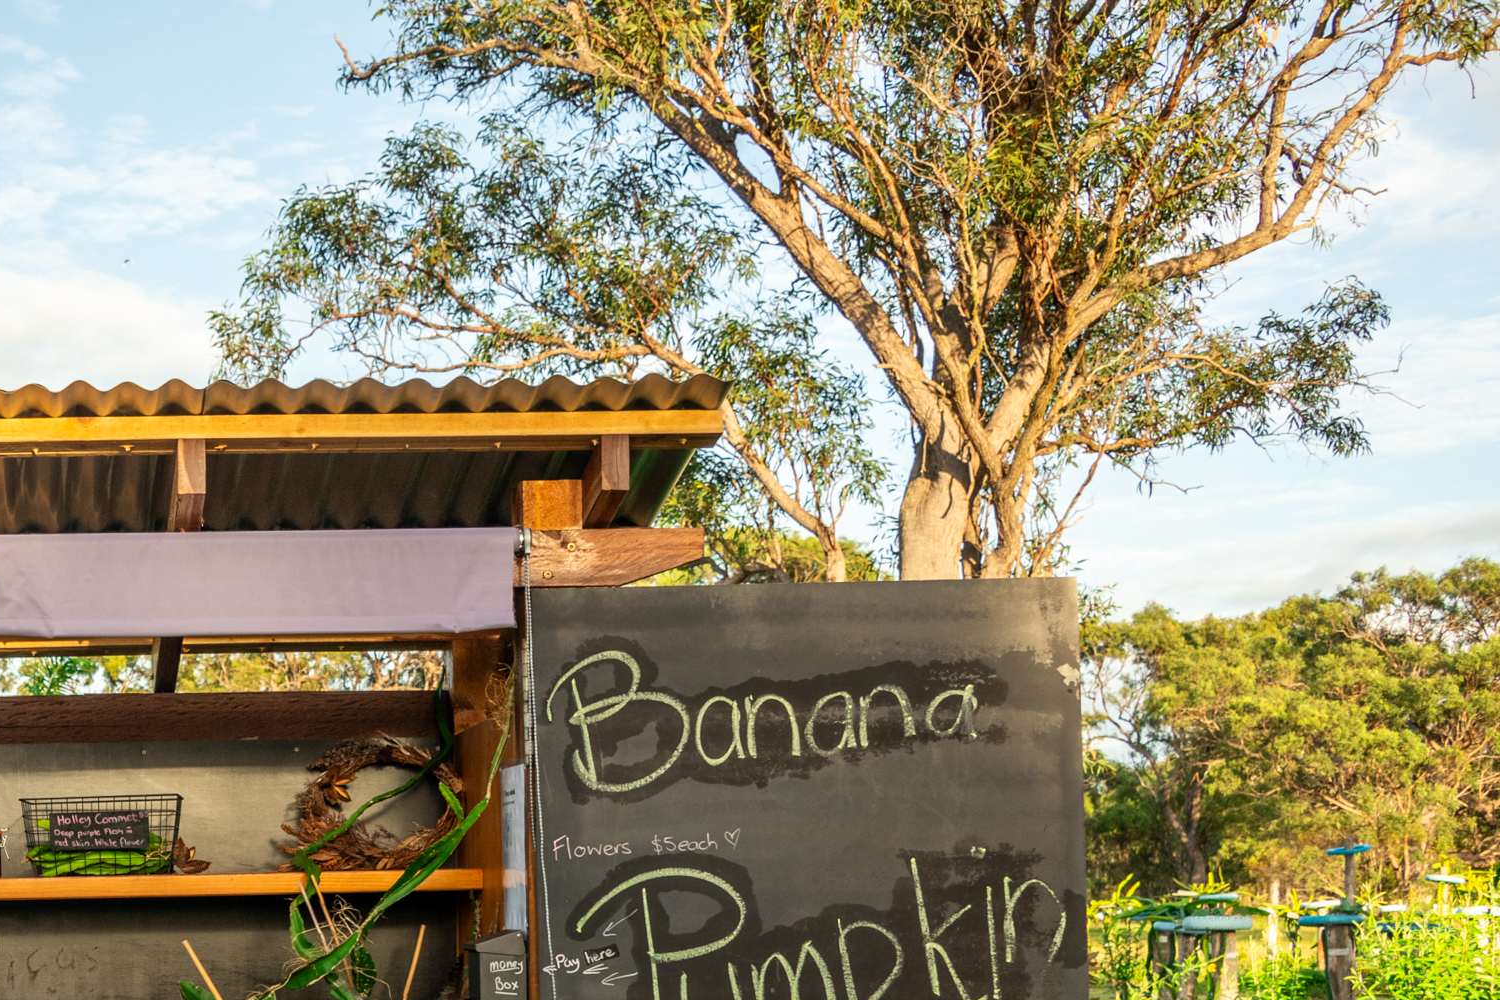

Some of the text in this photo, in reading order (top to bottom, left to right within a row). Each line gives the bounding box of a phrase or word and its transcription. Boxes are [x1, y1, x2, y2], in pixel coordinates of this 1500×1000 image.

[547, 650, 978, 792] Banana
[552, 834, 633, 862] Flowers
[555, 948, 616, 974] Pay here
